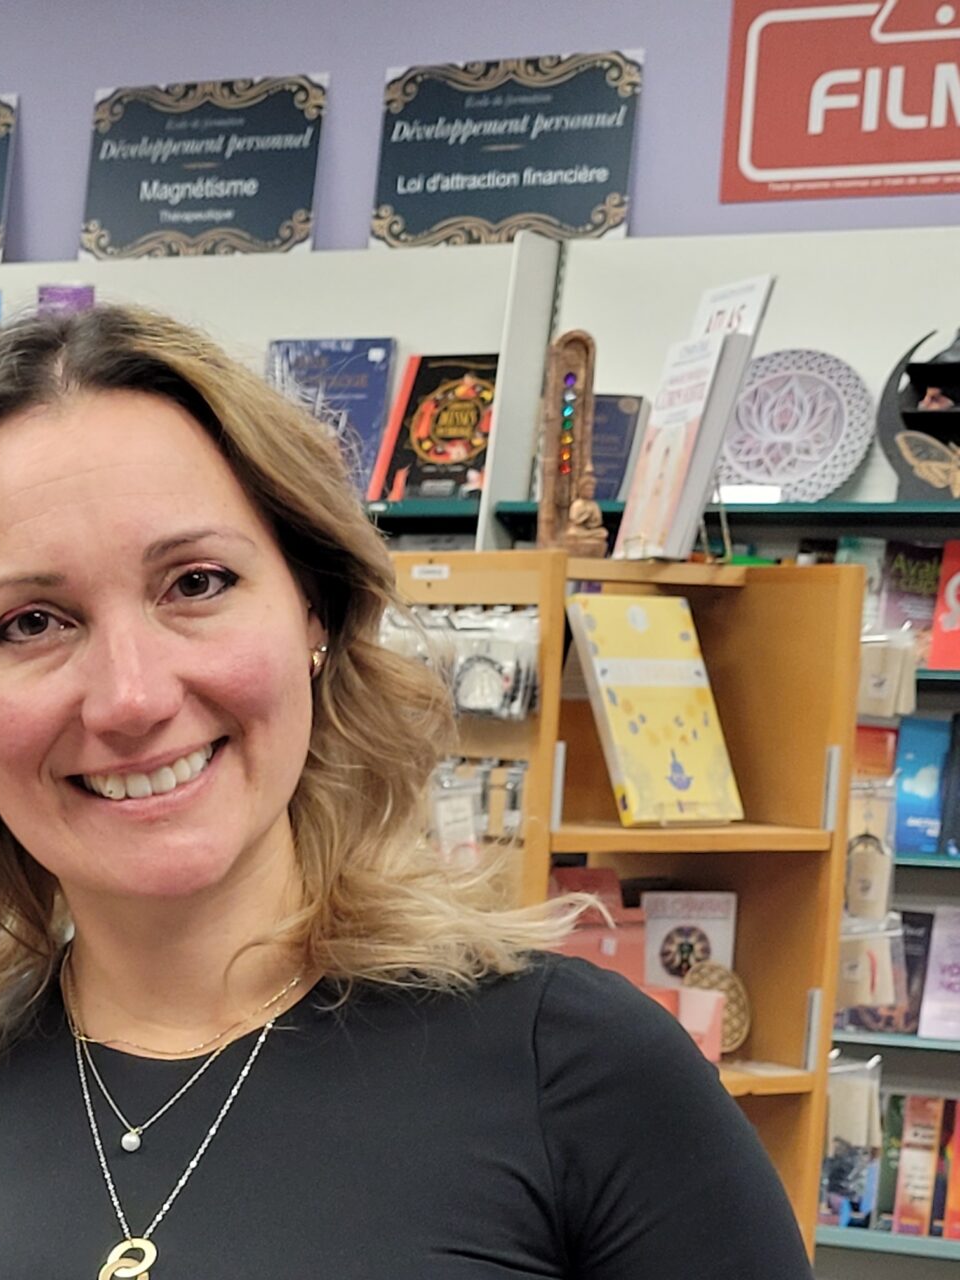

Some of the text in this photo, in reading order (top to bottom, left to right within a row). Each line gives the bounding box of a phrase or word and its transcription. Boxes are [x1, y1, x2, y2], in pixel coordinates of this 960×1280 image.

[138, 176, 260, 206] Magnétisme
[396, 163, 610, 195] Loi d'attraction financière
